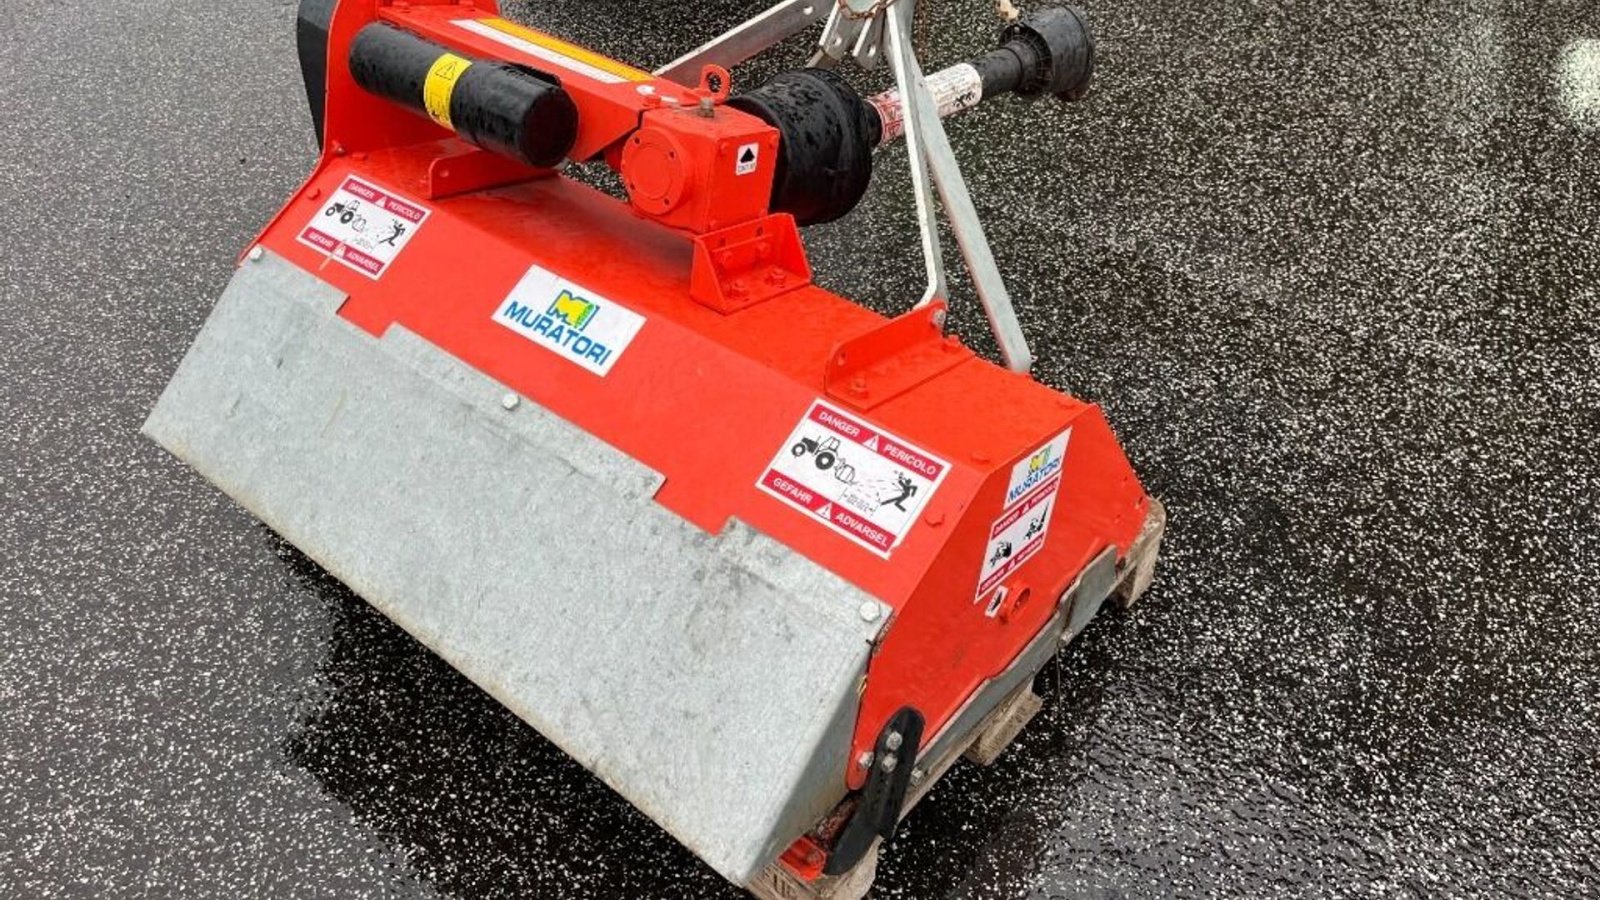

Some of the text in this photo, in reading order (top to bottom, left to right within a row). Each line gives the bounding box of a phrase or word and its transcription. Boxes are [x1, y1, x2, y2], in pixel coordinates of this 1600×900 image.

[503, 301, 613, 366] MURATORI
[818, 411, 937, 475] DANGER PERICOLO
[1008, 455, 1062, 503] MURATORI
[772, 477, 888, 547] GEFAHR ADVARSEL
